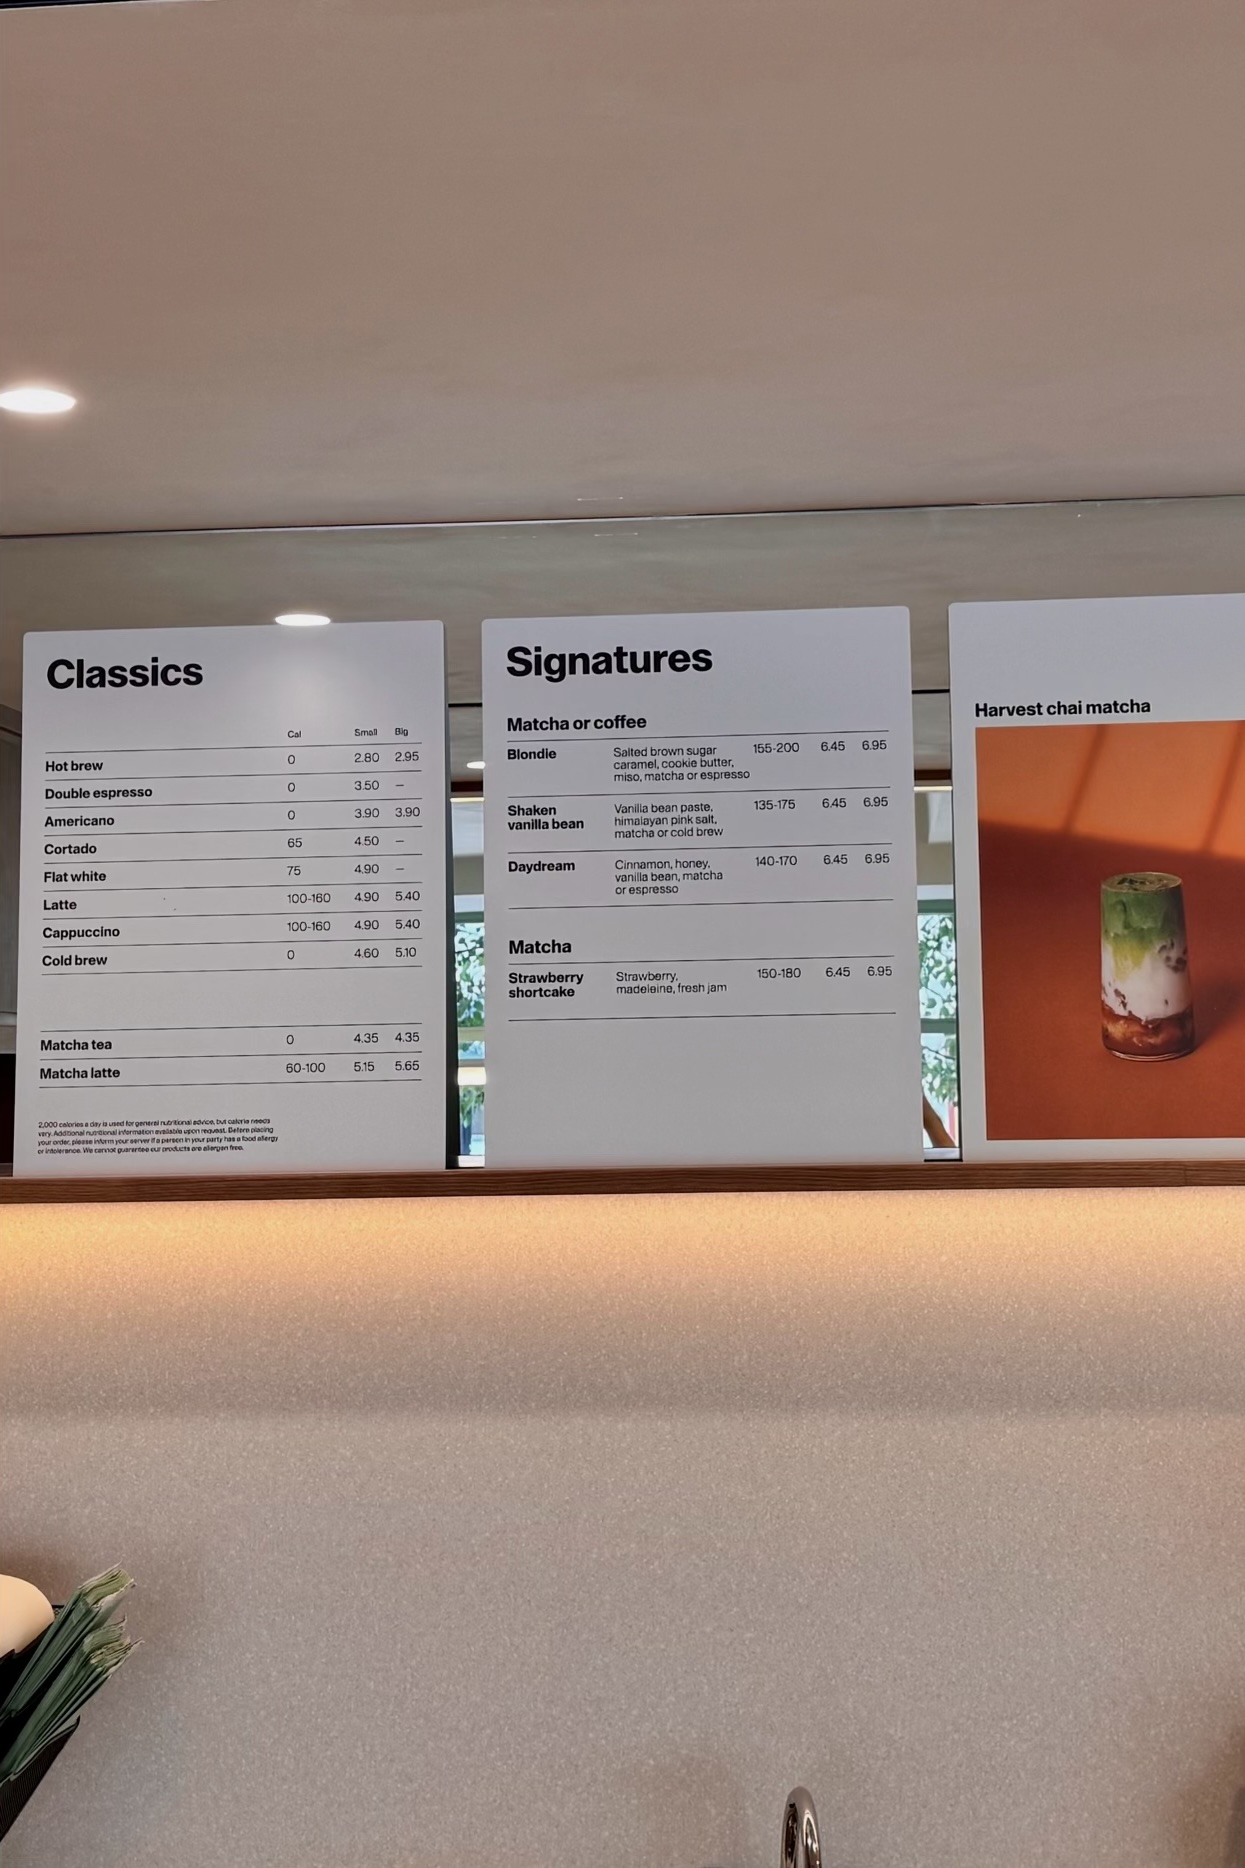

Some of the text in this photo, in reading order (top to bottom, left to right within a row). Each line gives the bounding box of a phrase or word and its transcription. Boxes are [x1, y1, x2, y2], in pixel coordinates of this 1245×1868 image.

[507, 646, 713, 683] Signatures
[47, 657, 203, 689] Classics
[974, 698, 1151, 718] Harvest chai matcha
[506, 714, 648, 732] Matcha or coffee
[287, 727, 409, 739] Cal Small Big
[613, 746, 718, 758] Salted brown sugar
[752, 739, 888, 754] 155-200 6.45 6.95
[354, 750, 420, 764] 2.80 2.95
[507, 747, 557, 761] Blondie
[45, 759, 104, 773] Hot brew
[613, 757, 735, 771] caramel, cookie butter,
[613, 770, 751, 783] miso, matcha espresso
[354, 779, 380, 791] 3.50
[44, 787, 153, 801] Double espresso
[507, 804, 557, 817] Shaken
[613, 802, 714, 815] Vanilla bean paste,
[753, 796, 889, 811] 135-175 6.45 6.95
[354, 806, 421, 819] 3.90 3.90
[43, 814, 115, 828] Americano
[507, 817, 585, 831] vanilla bean
[614, 813, 718, 828] himalayan pink salt,
[614, 826, 724, 839] matcha cold brew
[43, 842, 98, 856] Cortado
[287, 835, 380, 849] 65 4.50
[614, 858, 711, 871] Cinnamon, honey,
[755, 852, 891, 867] 140-170 6.45 6.95
[286, 863, 380, 877] 75 4.90
[507, 860, 576, 875] Daydream
[43, 870, 107, 884] Flat white
[614, 869, 724, 883] vanilla bean, matcha
[287, 890, 421, 904] 100-160 4.90 5.40
[628, 885, 679, 896] espresso
[43, 899, 78, 911] Latte
[286, 918, 421, 932] 100-160 4.90 5.40
[42, 925, 121, 941] Cappuccino
[353, 946, 417, 959] 4.60 5.10
[508, 938, 572, 955] Matcha
[41, 954, 108, 967] Cold brew
[508, 971, 585, 986] Strawberry
[615, 971, 679, 984] Strawberry,
[756, 965, 893, 979] 150-180 6.45 6.95
[508, 985, 576, 999] shortcake
[616, 982, 728, 995] madeleine, fresh jam
[353, 1031, 420, 1044] 4.35 4.35
[40, 1038, 113, 1052] Matcha tea
[39, 1066, 121, 1080] Matcha latte
[285, 1059, 420, 1074] 60-100 5.15 5.65
